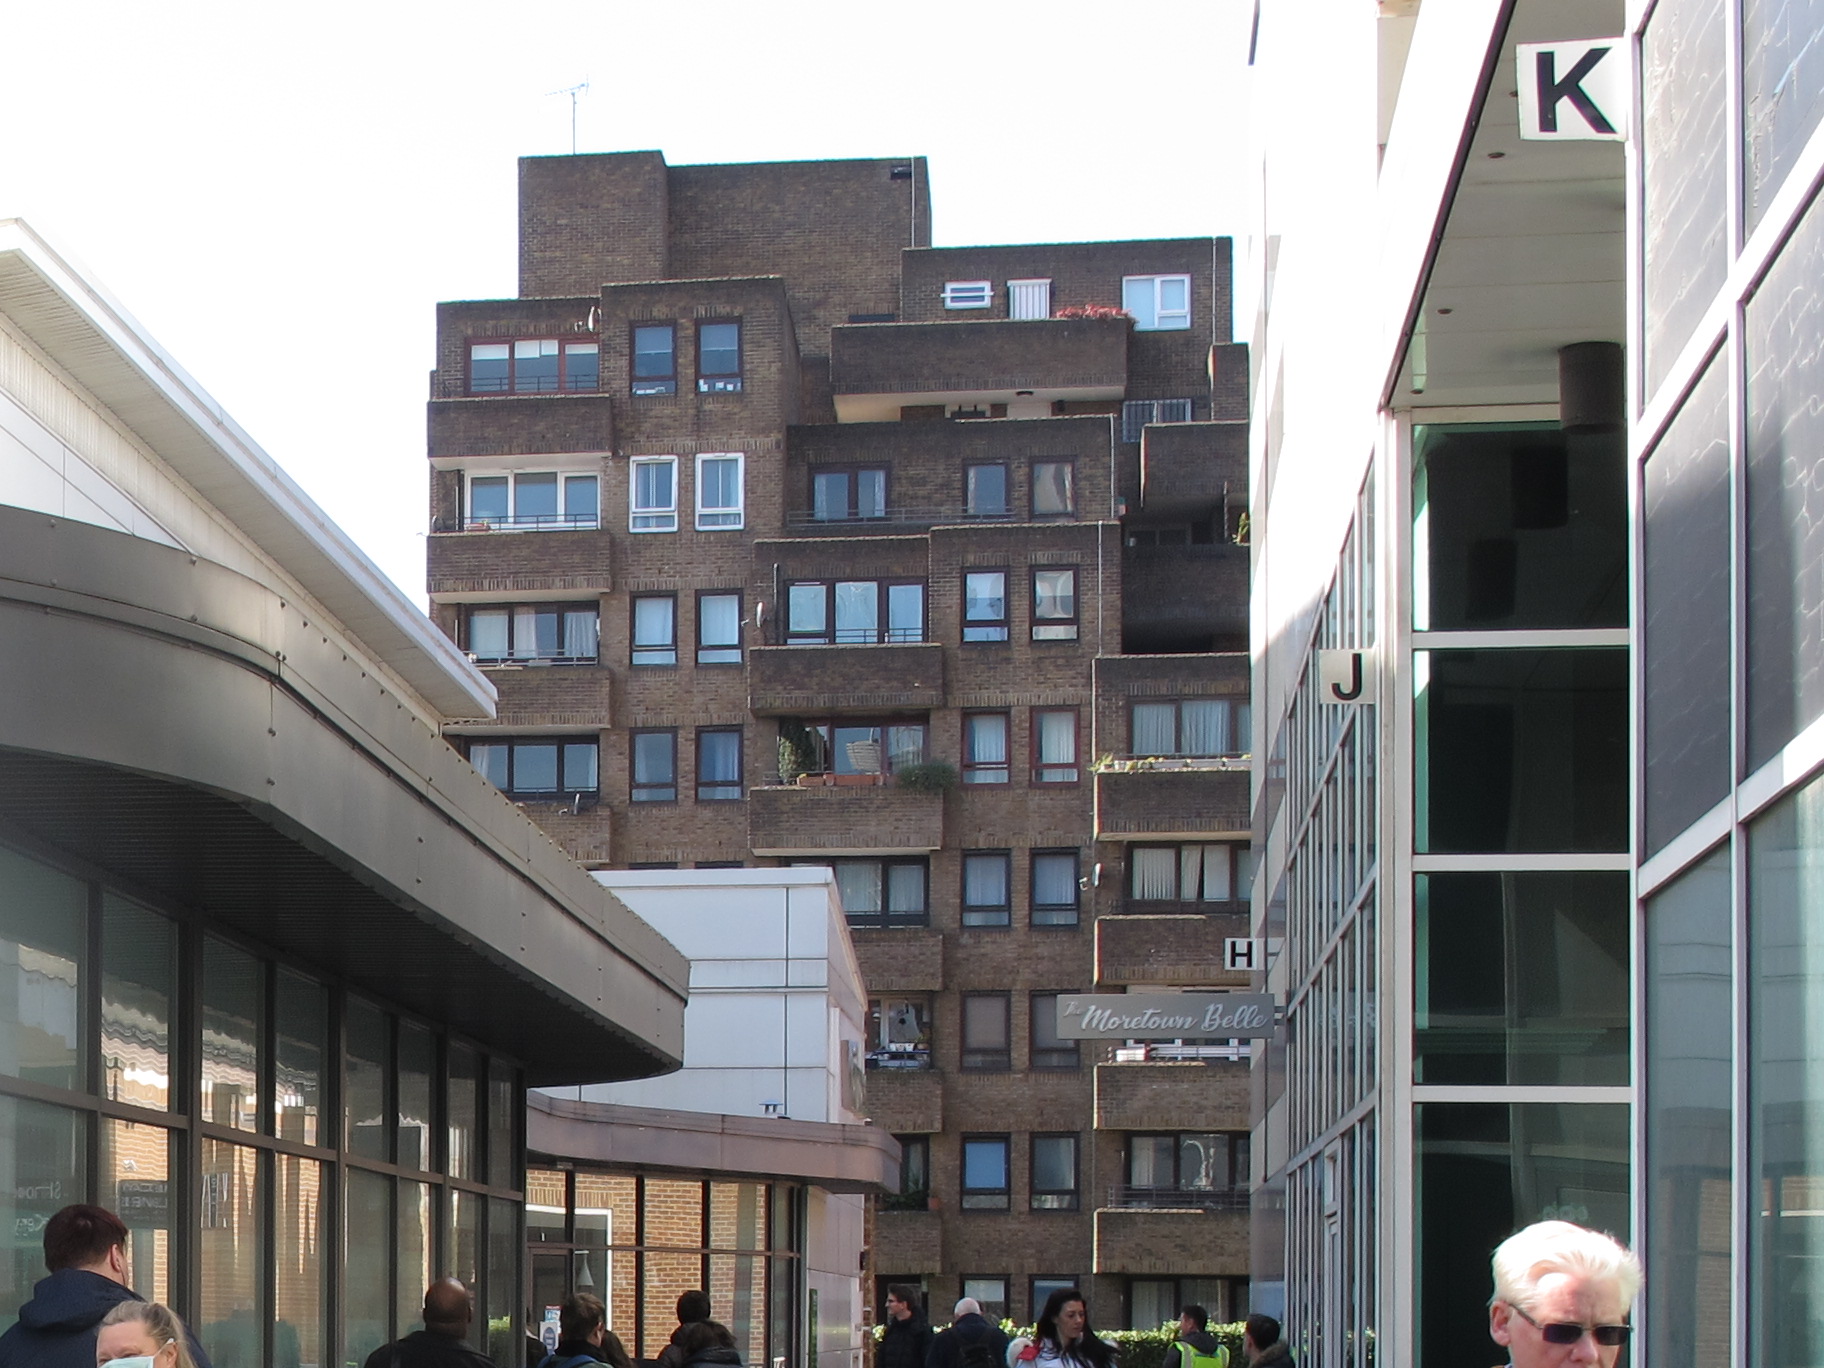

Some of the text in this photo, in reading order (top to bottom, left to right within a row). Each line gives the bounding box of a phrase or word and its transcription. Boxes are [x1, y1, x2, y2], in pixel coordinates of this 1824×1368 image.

[1536, 47, 1617, 133] K
[1331, 652, 1363, 701] J
[1230, 940, 1253, 968] H
[1063, 1001, 1269, 1033] The Moretown Belle
